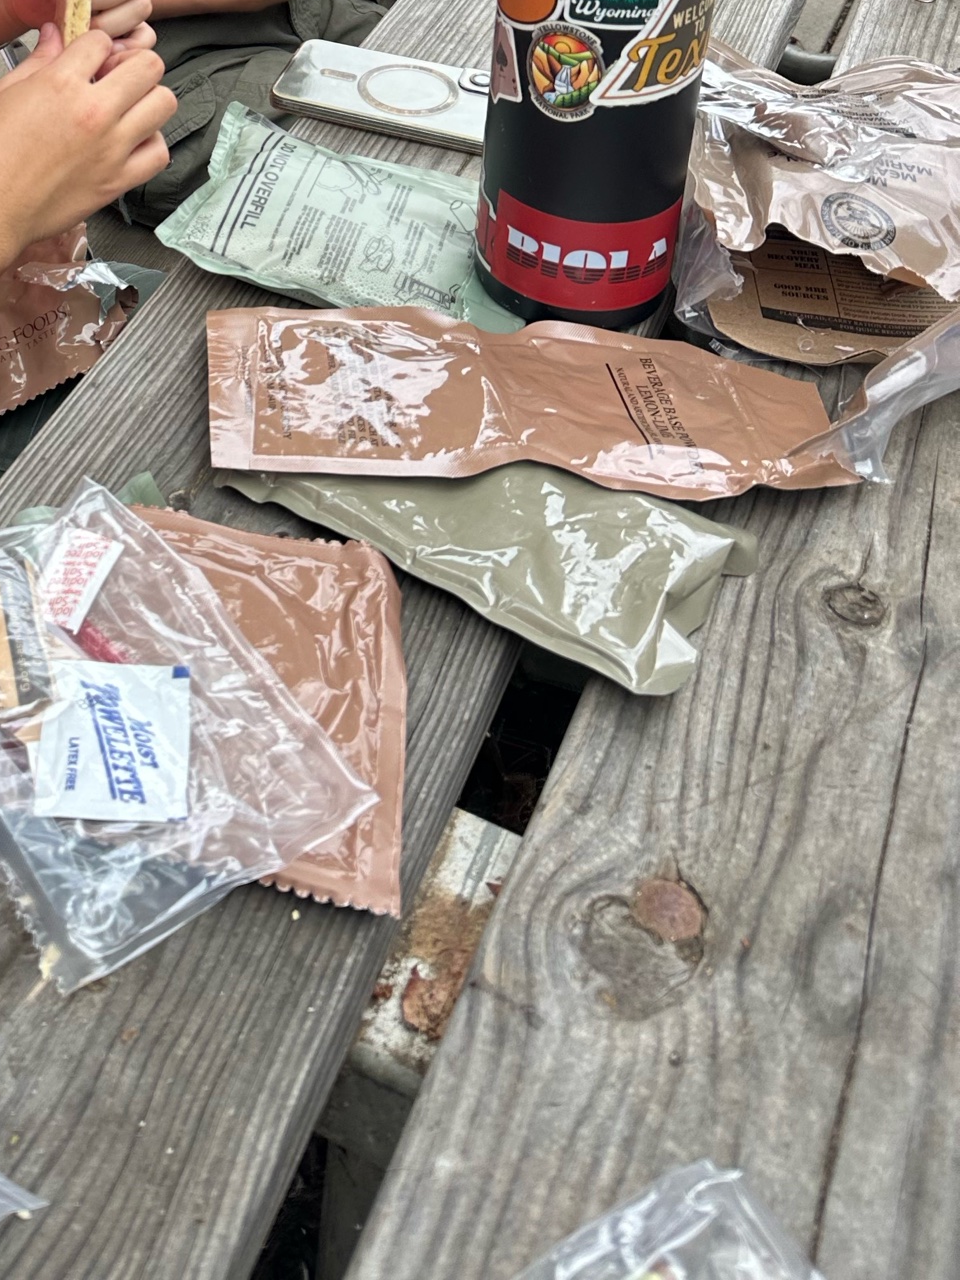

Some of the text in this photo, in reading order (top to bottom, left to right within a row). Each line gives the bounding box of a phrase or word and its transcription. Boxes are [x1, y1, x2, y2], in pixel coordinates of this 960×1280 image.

[537, 23, 598, 45] YELLOWSTONE
[694, 17, 706, 36] TO
[534, 96, 591, 120] NATIONAL PARK
[240, 143, 297, 230] DO NOT OVERFILL
[506, 224, 668, 285] BIOLA
[767, 253, 820, 264] RECOVERY
[790, 249, 819, 257] YOUR
[794, 261, 822, 270] MEAL
[774, 282, 828, 294] GOOD MRE
[781, 290, 829, 301] SOURCES
[13, 304, 68, 345] FOODS
[840, 324, 854, 332] FOR
[855, 326, 880, 334] QUICK
[26, 328, 56, 351] TASTE
[636, 384, 675, 440] LEMON-LIME
[639, 357, 704, 473] BEVERAGE BASE POWDER
[64, 736, 80, 792] LATEX FREE
